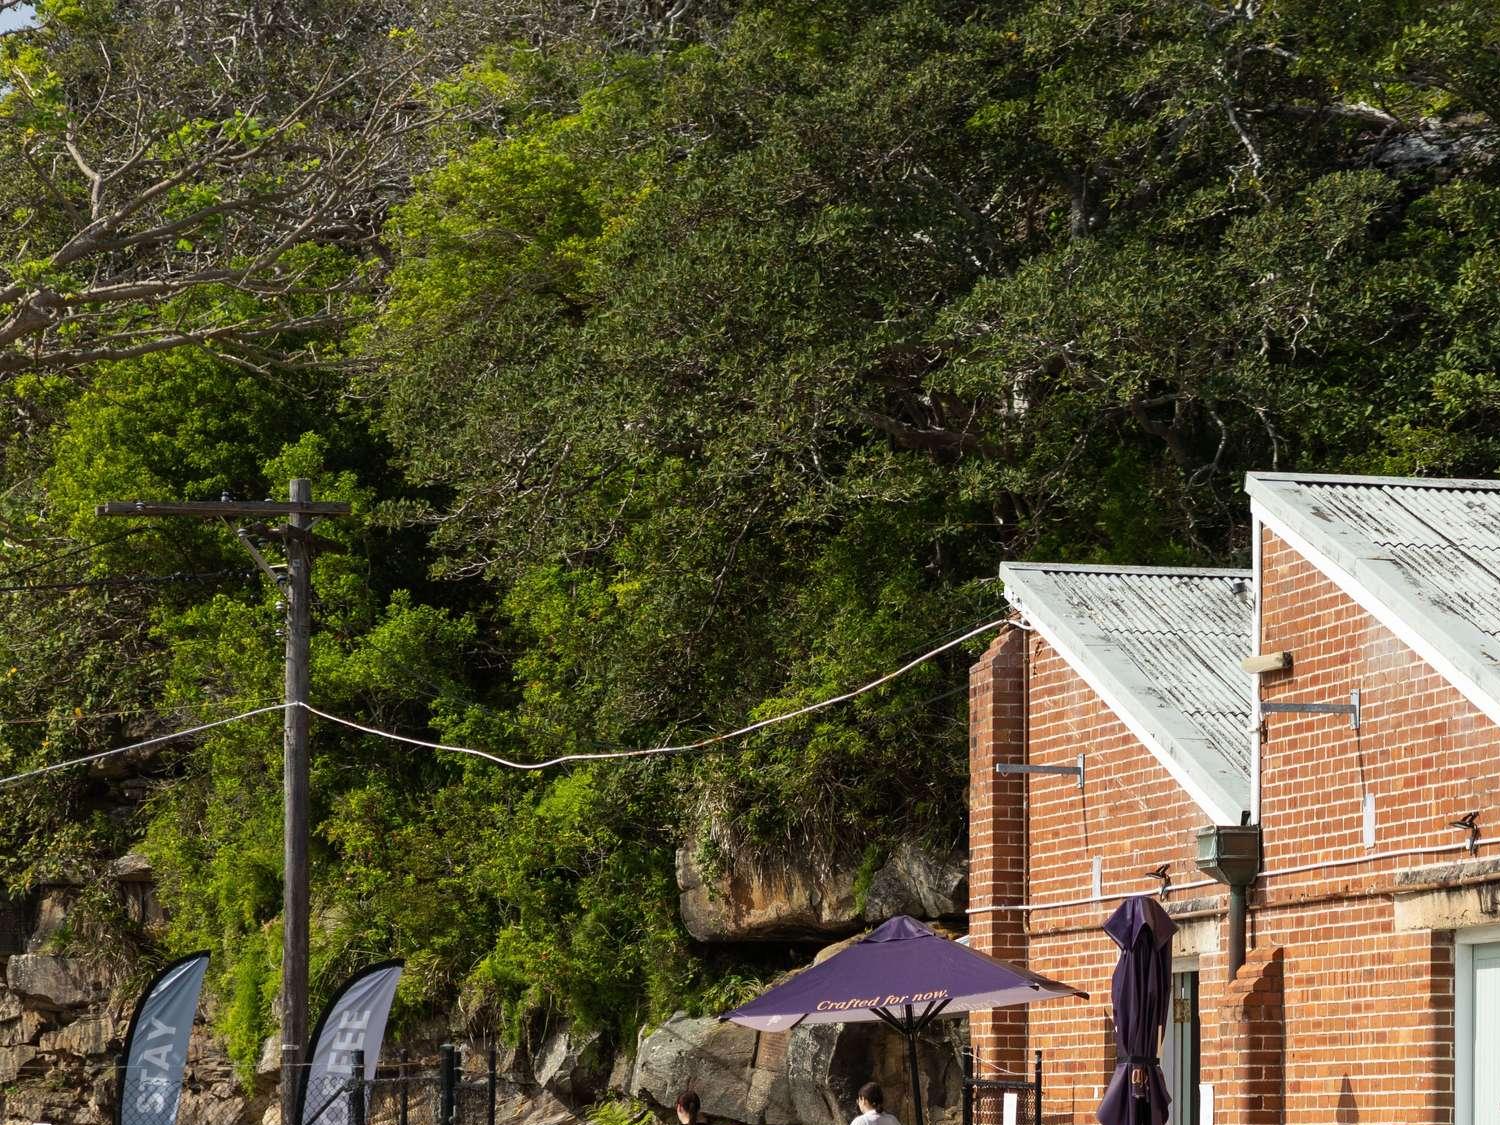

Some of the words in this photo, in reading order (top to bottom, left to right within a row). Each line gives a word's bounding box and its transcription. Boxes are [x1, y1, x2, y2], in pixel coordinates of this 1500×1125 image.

[816, 996, 881, 1011] Crafted
[880, 994, 909, 1006] for
[911, 989, 949, 1002] now.
[136, 1016, 177, 1114] STAY
